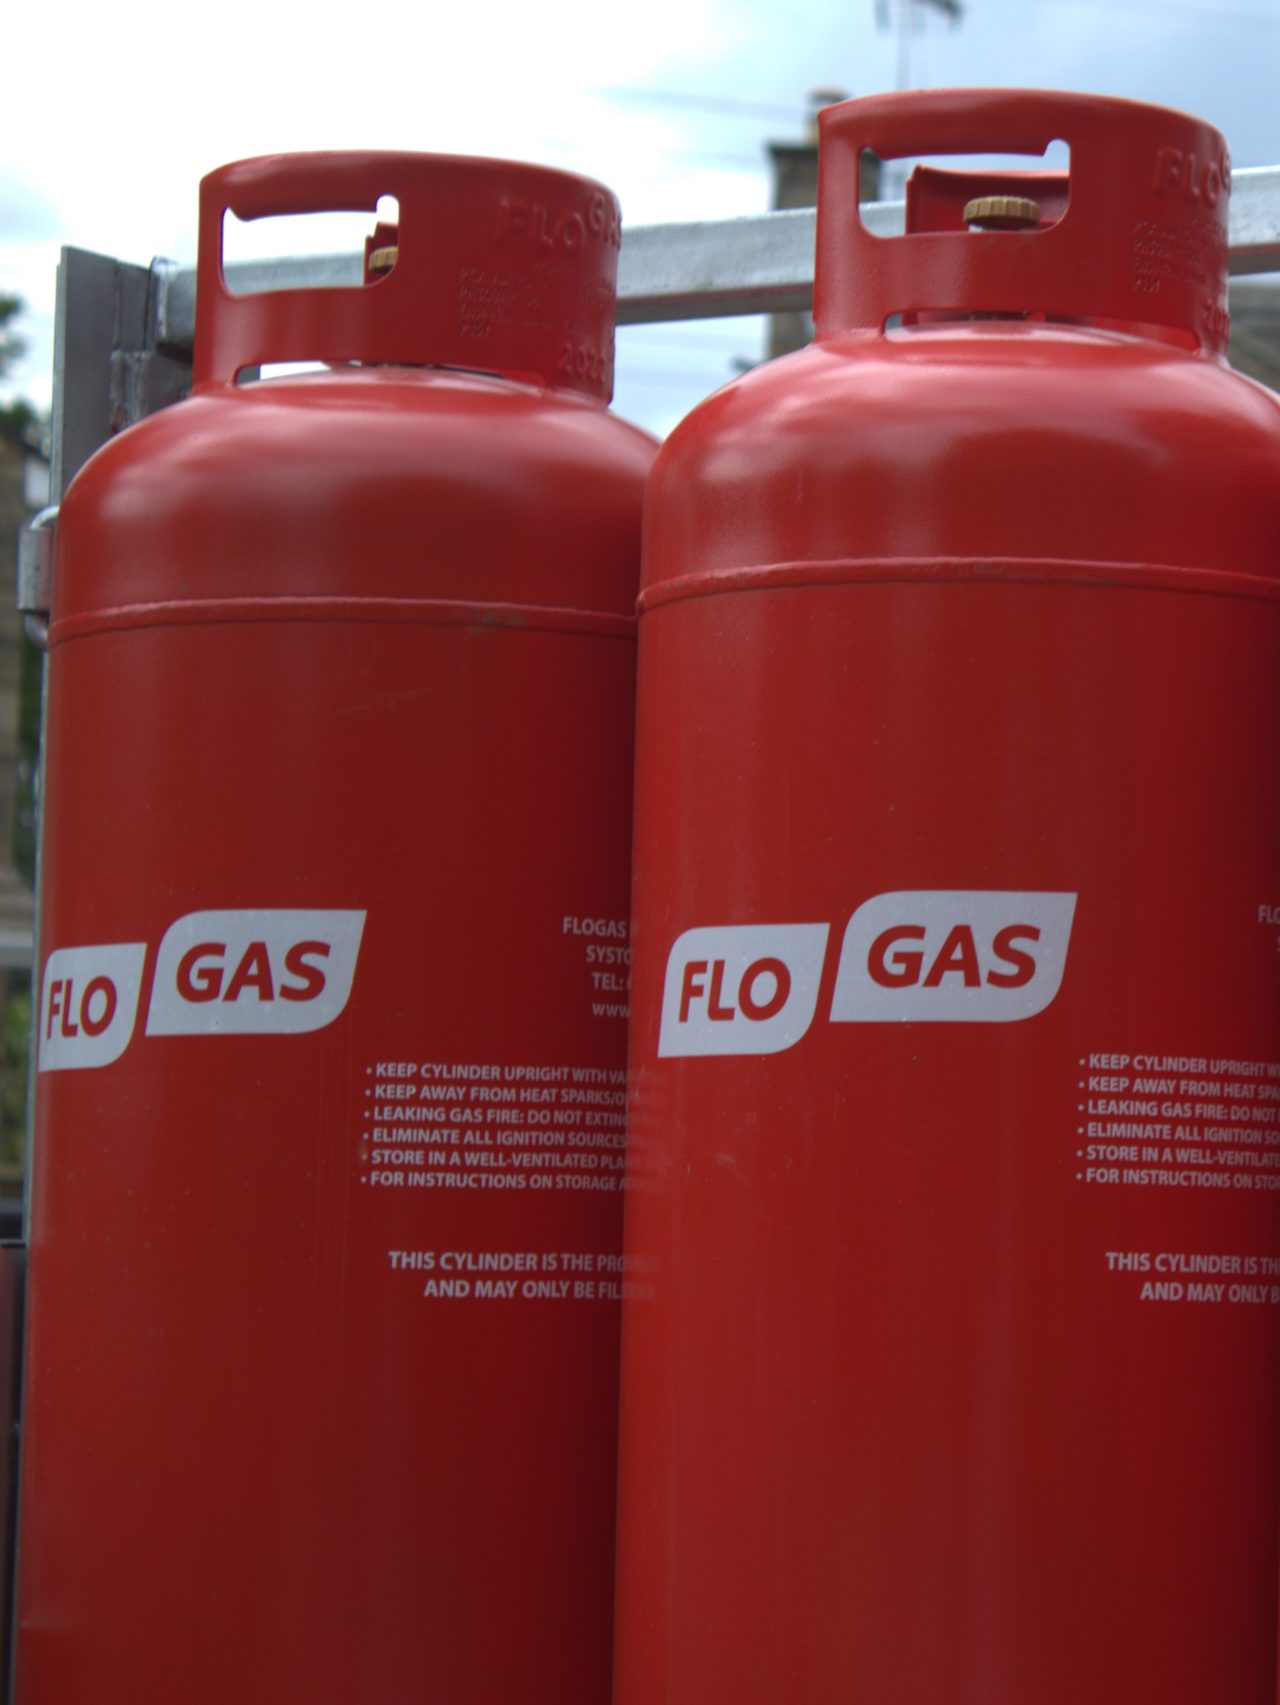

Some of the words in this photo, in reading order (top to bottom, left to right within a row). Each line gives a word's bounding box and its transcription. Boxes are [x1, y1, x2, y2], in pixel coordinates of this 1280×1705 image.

[562, 915, 626, 938] FLOGAS
[678, 957, 791, 1023] FLO
[867, 924, 1041, 989] GAS
[47, 975, 117, 1040] FLO
[176, 941, 331, 1003] GAS
[376, 1062, 417, 1078] KEEP
[420, 1063, 501, 1080] CYLINDER
[504, 1065, 569, 1082] UPRIGHT
[572, 1067, 607, 1083] WITH
[1089, 1053, 1130, 1069] KEEP
[1132, 1055, 1207, 1073] CYLINDER
[1209, 1058, 1266, 1077] UPRIGHT
[375, 1084, 416, 1100] KEEP
[420, 1085, 466, 1101] AWAY
[470, 1087, 516, 1103] FROM
[520, 1087, 558, 1104] HEAT
[1088, 1076, 1129, 1092] KEEP
[1132, 1078, 1176, 1094] AWAY
[1179, 1080, 1221, 1097] FROM
[1223, 1082, 1257, 1099] HEAT
[374, 1106, 446, 1122] LEAKING
[449, 1108, 483, 1123] GAS
[486, 1108, 524, 1125] FIRE:
[527, 1109, 551, 1125] DO
[553, 1109, 583, 1125] NOT
[1087, 1099, 1158, 1117] LEAKING
[1161, 1102, 1192, 1118] GAS
[1194, 1103, 1229, 1120] FIRE:
[1229, 1104, 1251, 1121] DO
[1252, 1106, 1276, 1122] NOT
[372, 1127, 460, 1143] ELIMINATE
[463, 1129, 493, 1145] ALL
[496, 1130, 565, 1146] IGNITION
[1086, 1122, 1172, 1140] ELIMINATE
[1174, 1125, 1202, 1141] ALL
[1203, 1126, 1263, 1145] IGNITION
[371, 1149, 425, 1165] STORE
[428, 1150, 446, 1166] IN
[449, 1151, 461, 1166] A
[464, 1151, 599, 1169] WELL-VENTILATED
[1085, 1144, 1138, 1162] STORE
[1141, 1146, 1158, 1163] IN
[1161, 1146, 1173, 1163] A
[370, 1170, 405, 1187] FOR
[408, 1171, 527, 1189] INSTRUCTIONS
[529, 1173, 553, 1190] ON
[555, 1174, 617, 1191] STORAGE
[1085, 1167, 1120, 1185] FOR
[1122, 1168, 1231, 1188] INSTRUCTIONS
[1232, 1172, 1253, 1189] ON
[388, 1250, 435, 1271] THIS
[439, 1251, 538, 1272] CYLINDER
[541, 1252, 558, 1272] IS
[560, 1253, 594, 1272] THE
[1105, 1251, 1150, 1272] THIS
[1154, 1252, 1241, 1275] CYLINDER
[1244, 1255, 1258, 1275] IS
[423, 1278, 470, 1299] AND
[473, 1279, 519, 1299] MAY
[521, 1280, 571, 1300] ONLY
[573, 1280, 595, 1300] BE
[1139, 1280, 1184, 1301] AND
[1187, 1281, 1226, 1302] MAY
[1228, 1284, 1269, 1304] ONLY
